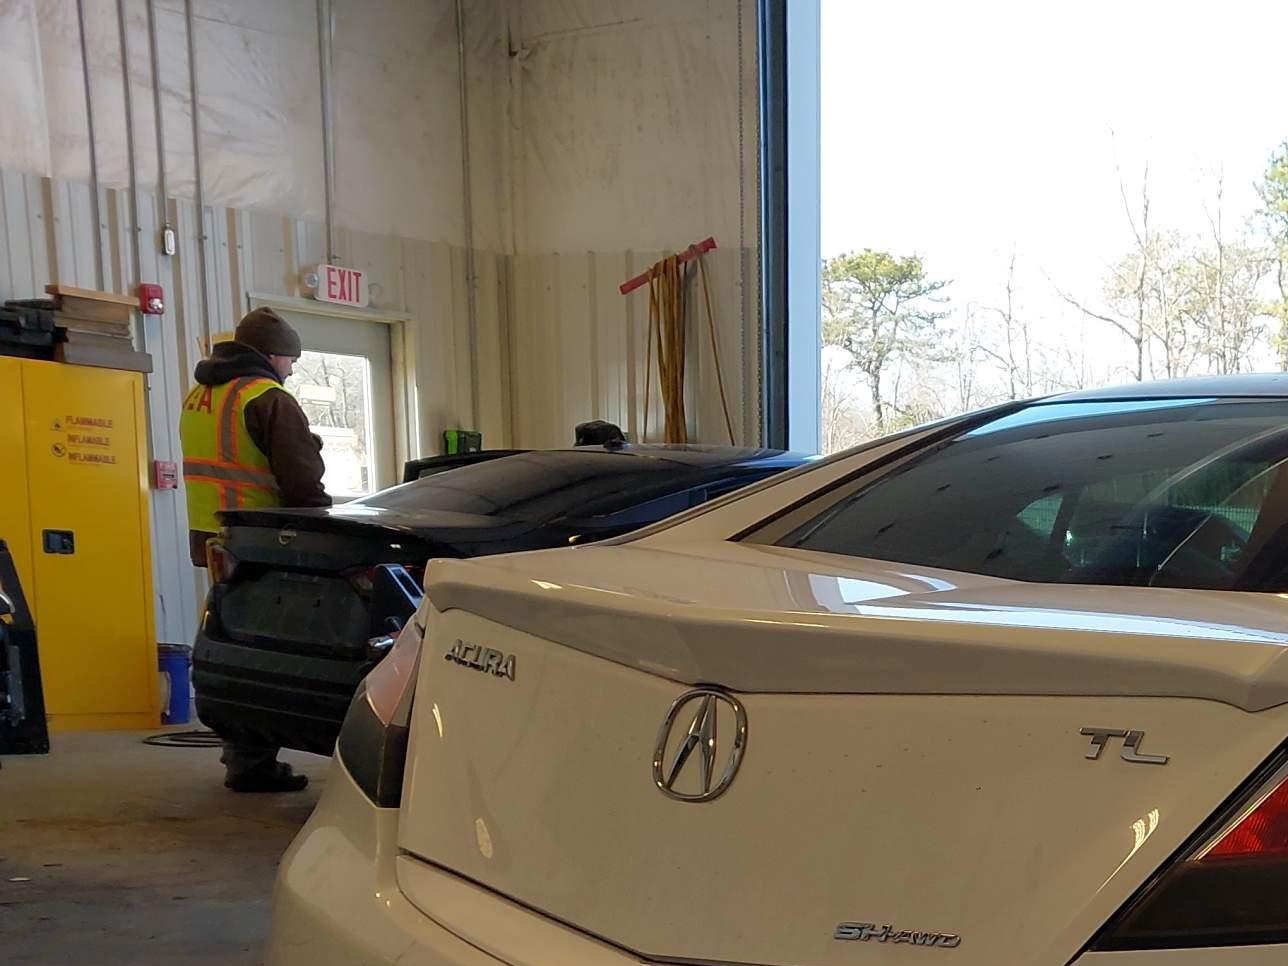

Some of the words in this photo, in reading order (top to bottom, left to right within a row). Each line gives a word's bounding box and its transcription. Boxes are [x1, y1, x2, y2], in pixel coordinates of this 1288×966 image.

[327, 266, 362, 303] EXIT
[445, 639, 516, 681] ACURA
[1080, 727, 1169, 765] TL
